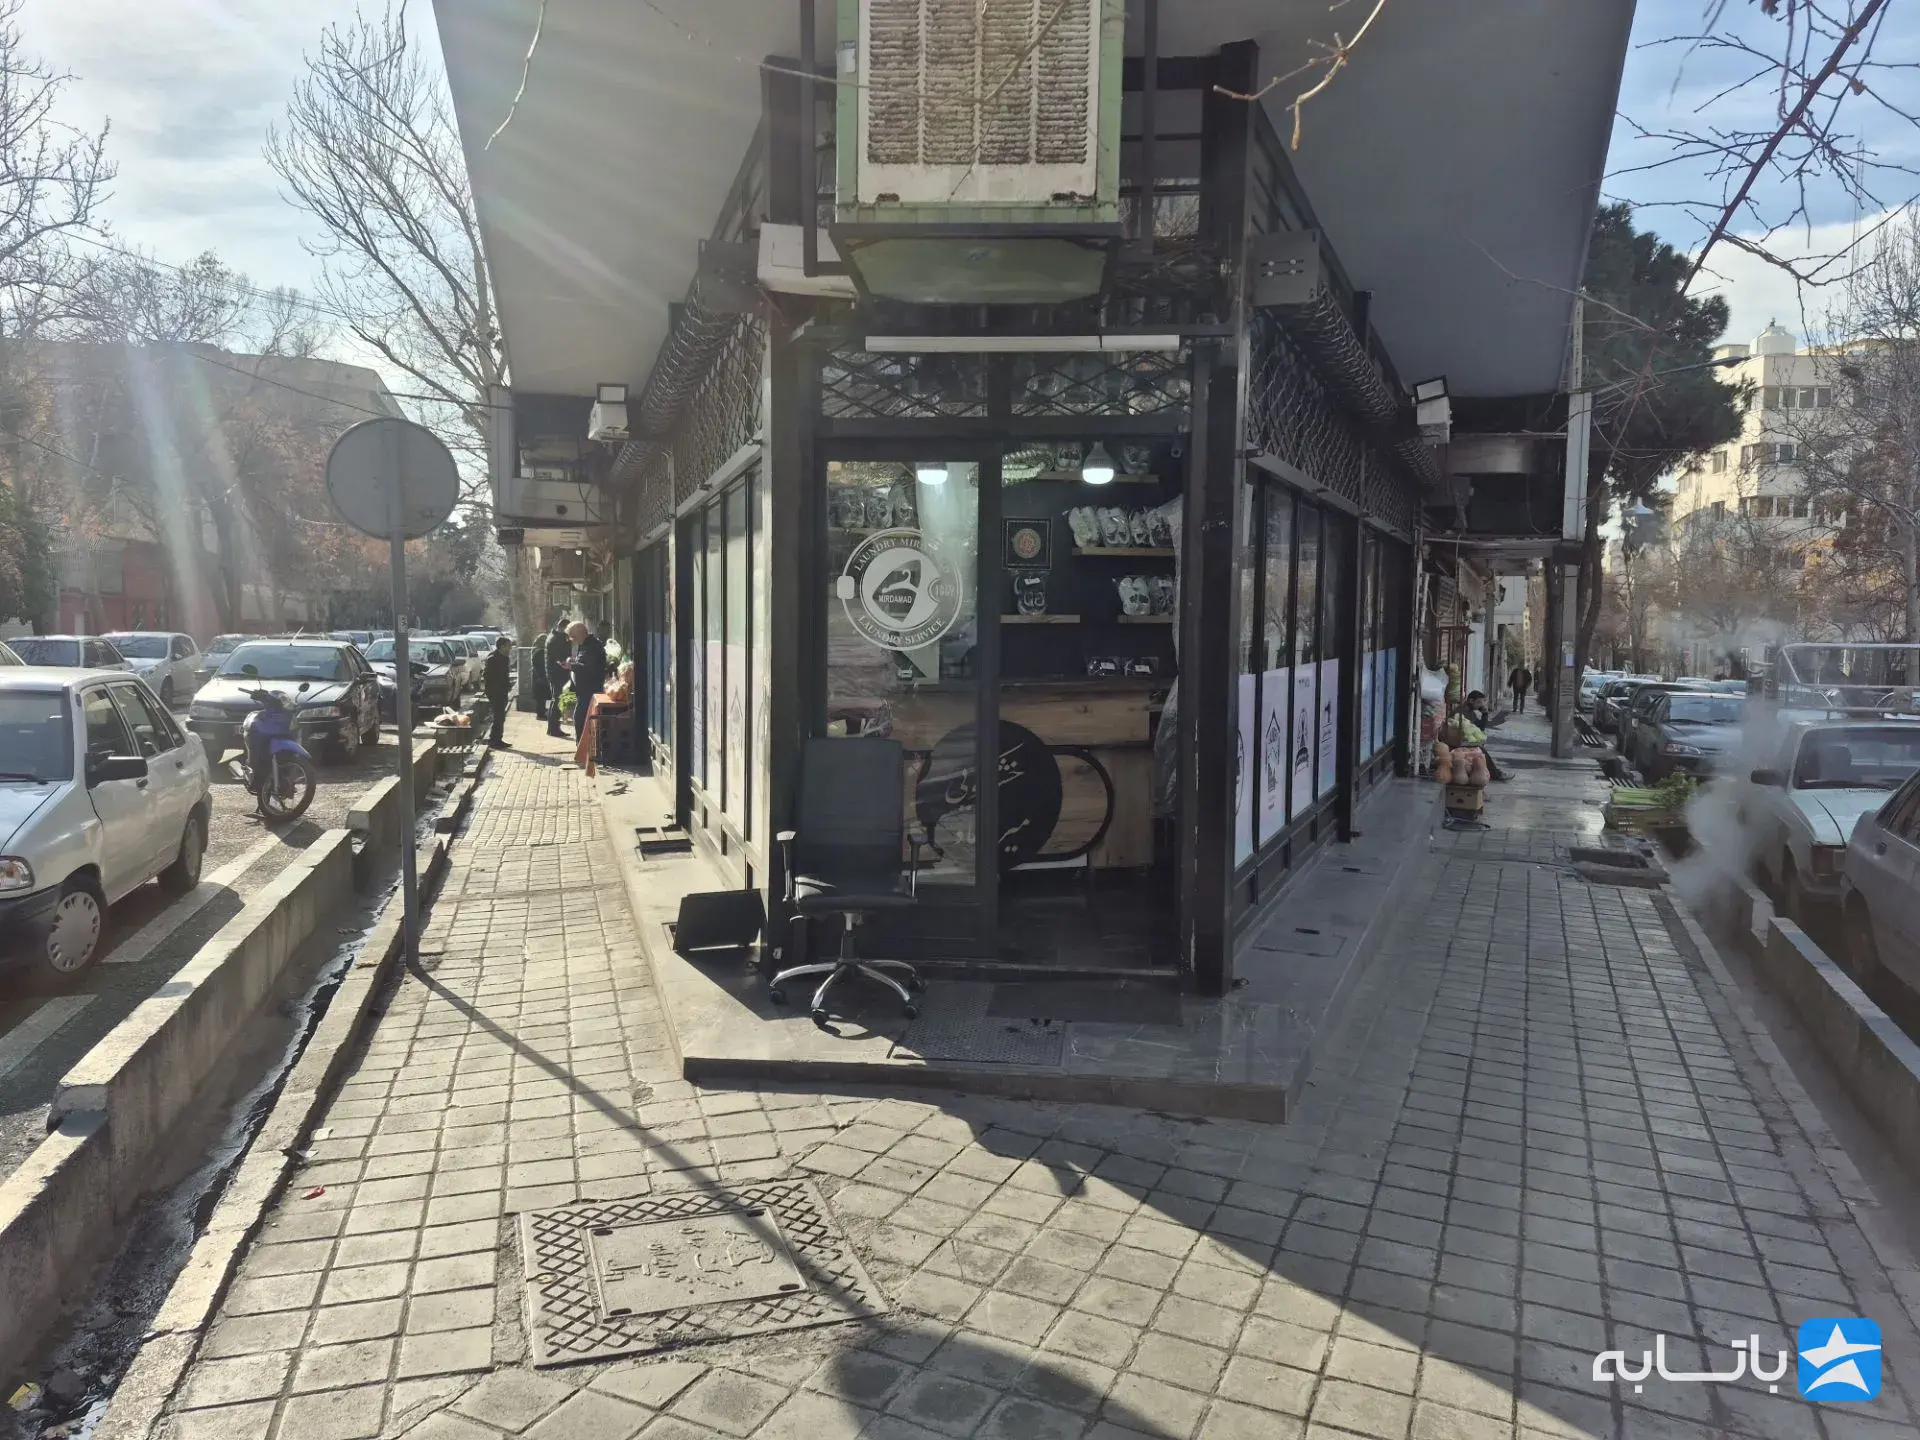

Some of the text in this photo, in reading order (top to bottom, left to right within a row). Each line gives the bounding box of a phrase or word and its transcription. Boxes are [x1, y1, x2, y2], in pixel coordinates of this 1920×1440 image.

[854, 538, 896, 571] LAUNDRY
[878, 594, 912, 604] MIRDAMAD
[858, 615, 945, 644] LAUNDRY SERVICE
